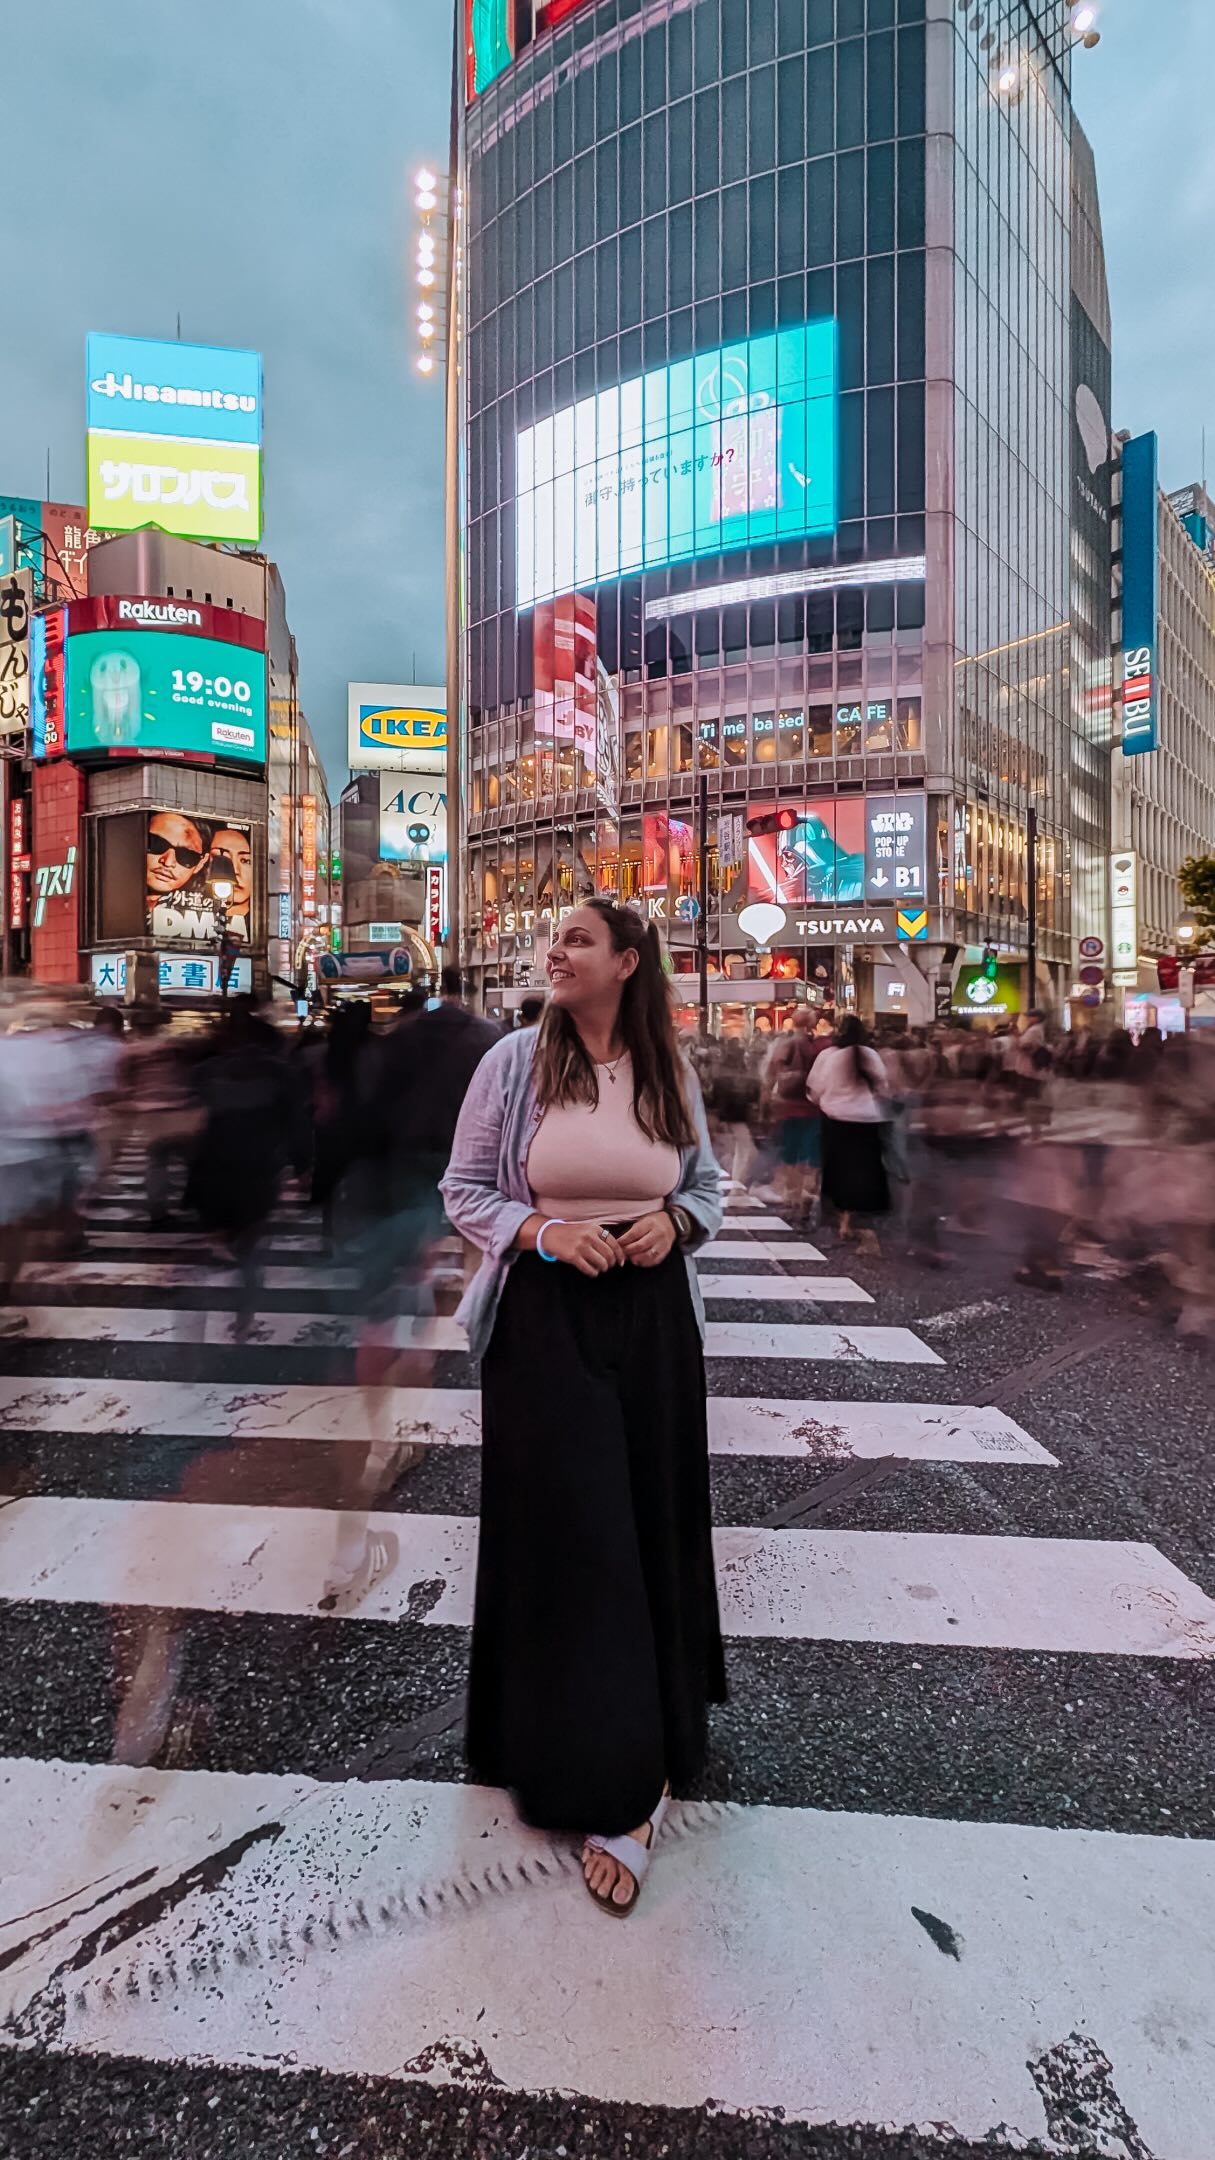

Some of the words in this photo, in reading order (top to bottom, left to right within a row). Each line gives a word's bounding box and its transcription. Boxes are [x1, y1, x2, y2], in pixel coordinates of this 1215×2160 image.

[91, 371, 256, 413] Hisamitsu
[100, 460, 249, 511] サロンパス
[63, 525, 117, 550] 龍角
[119, 600, 201, 626] Rakuten
[0, 577, 29, 726] もんじゃ
[172, 669, 251, 702] 19:00
[1124, 646, 1150, 737] SEIBU
[172, 693, 204, 706] Good
[207, 699, 253, 717] evening
[216, 727, 251, 742] Rakuten
[701, 720, 745, 740] Time
[754, 712, 805, 731] based
[837, 703, 887, 724] CAFE
[875, 835, 909, 848] POP-UP
[875, 846, 905, 858] STORE
[33, 846, 77, 927] クスリ
[896, 866, 920, 888] B1
[430, 875, 439, 926] カラオケ
[796, 918, 885, 935] TSUTAYA
